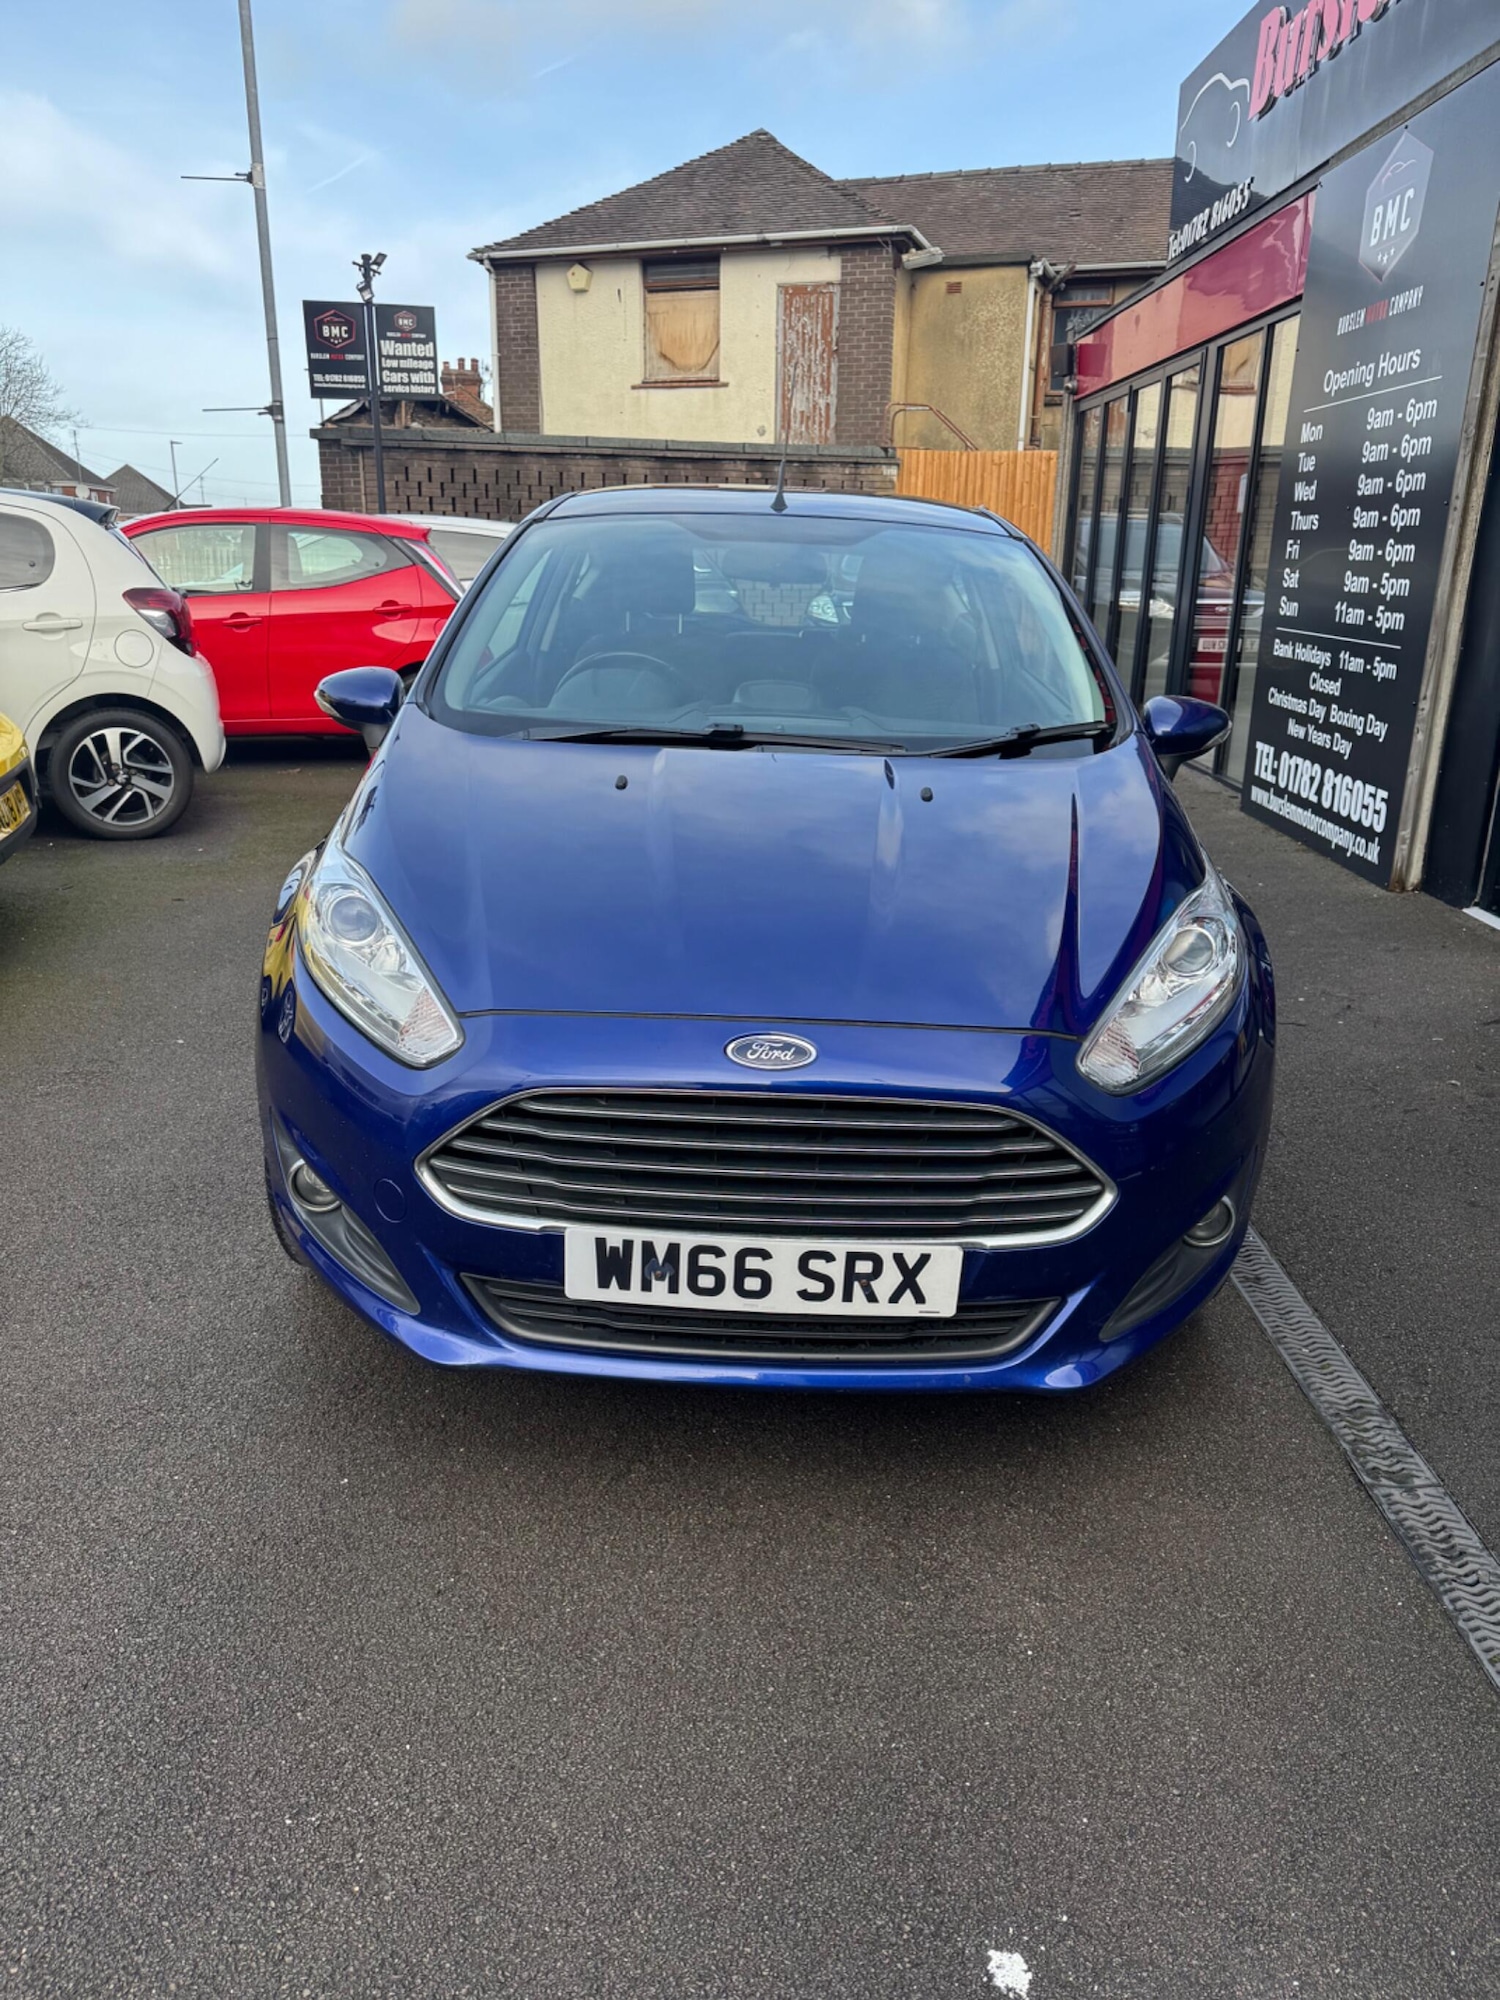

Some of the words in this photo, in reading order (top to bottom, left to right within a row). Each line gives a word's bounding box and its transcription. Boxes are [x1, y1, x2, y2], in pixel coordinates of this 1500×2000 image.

[1370, 188, 1414, 247] BMC
[322, 325, 348, 338] BMC
[380, 340, 435, 357] Wanted
[381, 357, 399, 368] Low
[399, 358, 434, 370] mileage
[382, 370, 409, 383] Cars
[410, 371, 435, 384] with
[1323, 361, 1375, 396] Opening
[1378, 348, 1421, 378] Hours
[383, 384, 410, 393] service
[410, 385, 436, 395] history
[1300, 422, 1323, 444] Mon
[1366, 407, 1394, 431] 9am
[1406, 398, 1438, 427] 6pm
[1298, 452, 1316, 473] Tue
[1361, 441, 1389, 464] 9am
[1400, 434, 1432, 463] 6pm
[1294, 480, 1317, 502] Wed
[1357, 473, 1384, 496] 9am
[1395, 469, 1426, 498] 6pm
[1290, 510, 1319, 531] Thurs
[1352, 506, 1379, 529] 9am
[1390, 503, 1421, 533] 6pm
[1285, 539, 1301, 560] Fri
[1348, 539, 1375, 562] 9am
[1385, 538, 1416, 568] 6pm
[1282, 567, 1299, 589] Sat
[1343, 570, 1370, 594] 9am
[1380, 573, 1410, 601] 5pm
[1278, 595, 1299, 617] Sun
[1334, 601, 1365, 626] 11am
[1375, 605, 1405, 634] 5pm
[1272, 638, 1294, 658] Bank
[1294, 642, 1332, 670] Holidays
[1339, 650, 1364, 673] 11am
[1372, 656, 1397, 682] 5pm
[1309, 671, 1342, 696] Closed
[1268, 686, 1308, 714] Christmas
[1308, 698, 1327, 724] Day
[1329, 704, 1364, 736] Boxing
[1366, 713, 1388, 742] Day
[1287, 718, 1305, 740] New
[1307, 724, 1332, 749] Years
[1332, 732, 1353, 760] Day
[1278, 750, 1321, 804] 01782
[1321, 768, 1389, 833] 816055
[746, 1042, 796, 1061] Ford
[594, 1236, 774, 1300] WM66
[796, 1249, 932, 1305] SRX
